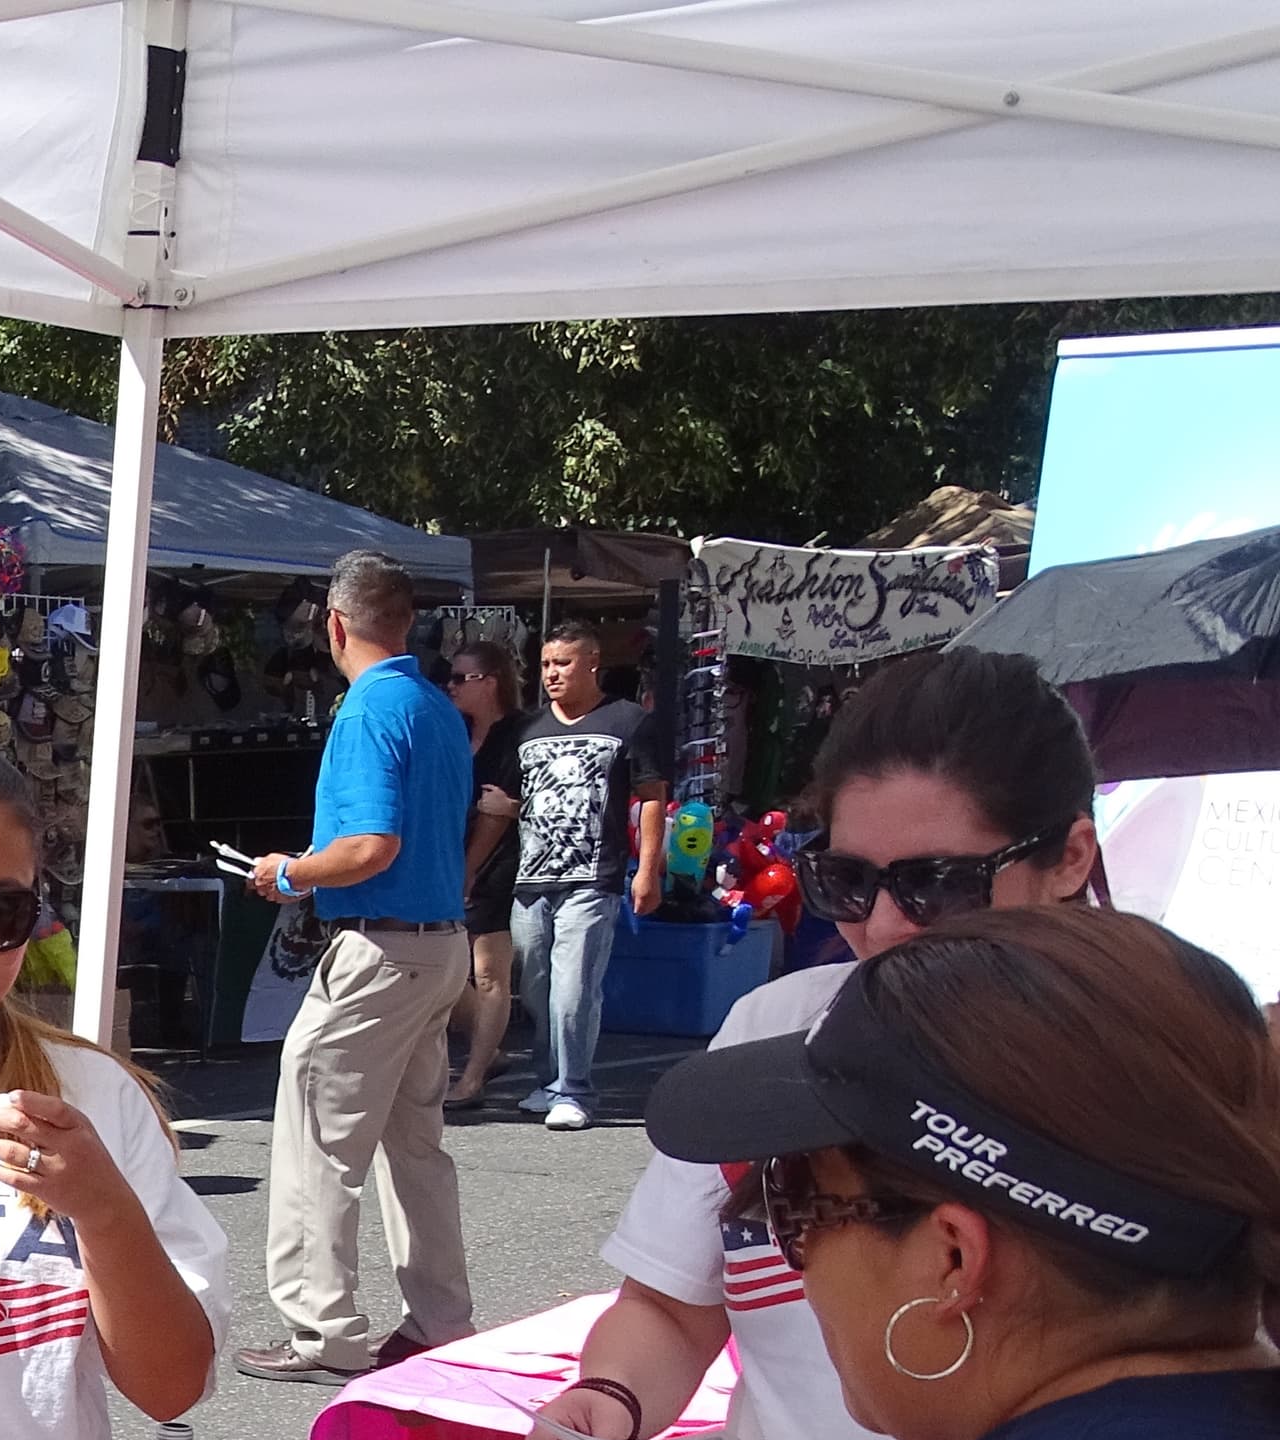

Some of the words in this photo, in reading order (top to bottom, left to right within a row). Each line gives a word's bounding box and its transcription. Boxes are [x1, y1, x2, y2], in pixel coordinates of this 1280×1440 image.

[1206, 799, 1280, 823] MEXI
[910, 1100, 1008, 1163] TOUR
[912, 1134, 1149, 1243] PREFERRED
